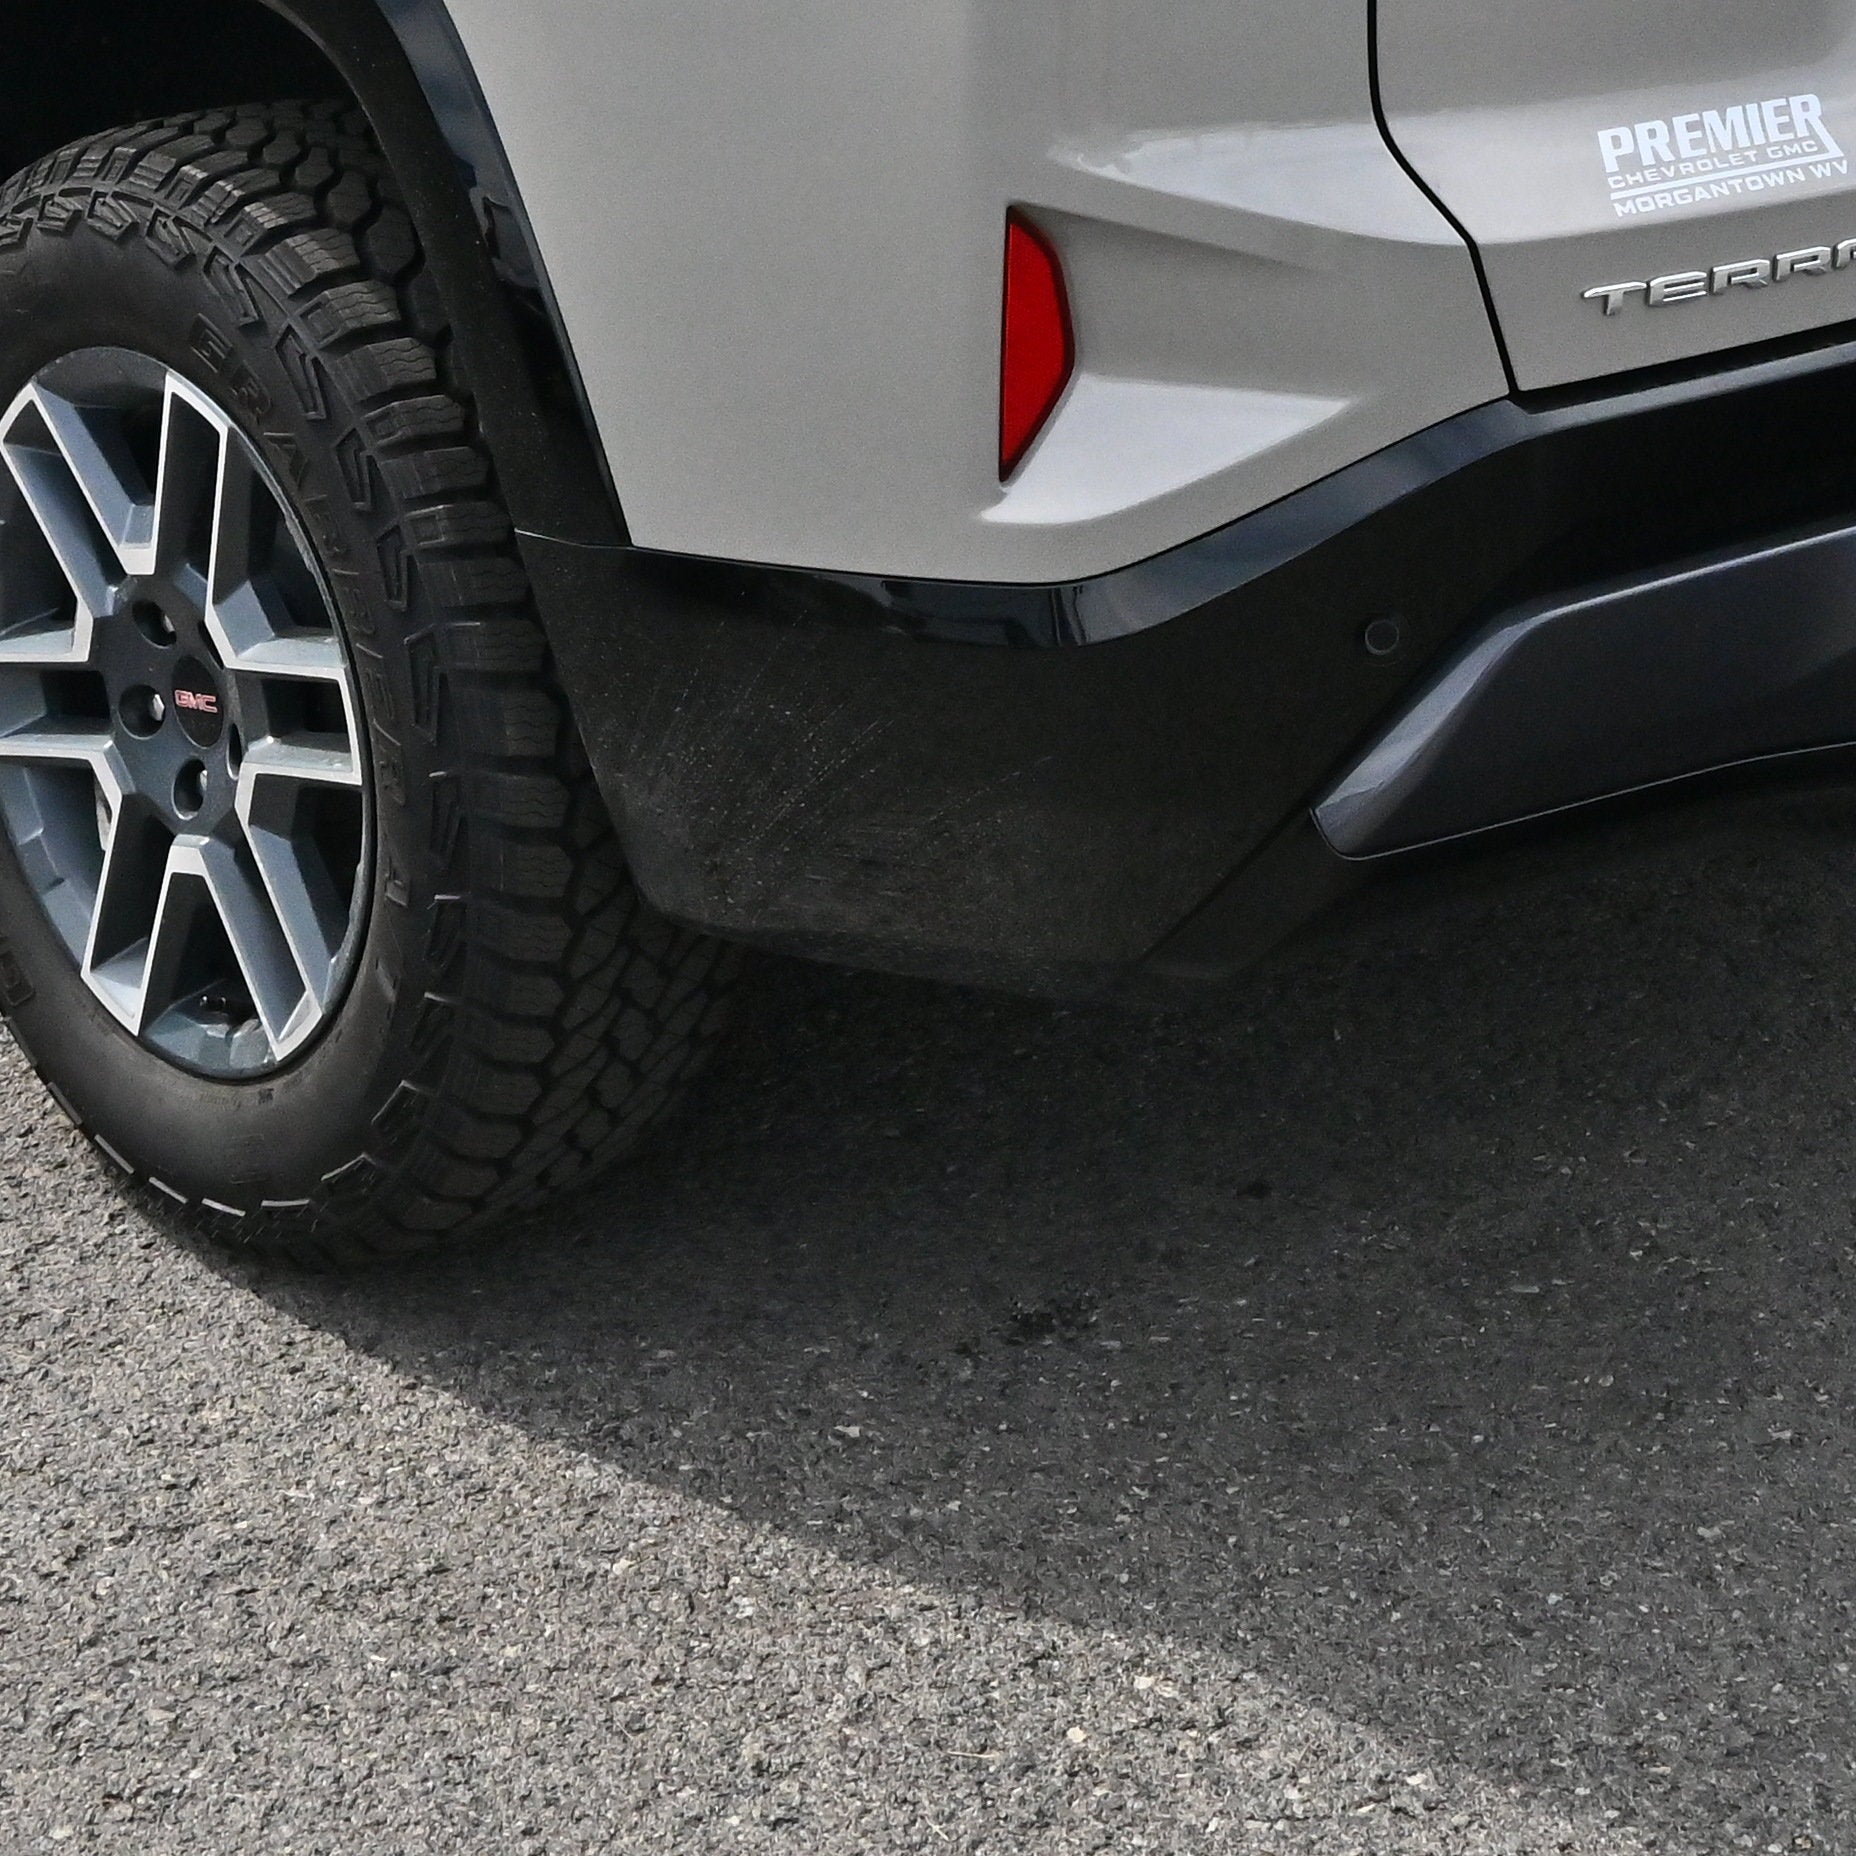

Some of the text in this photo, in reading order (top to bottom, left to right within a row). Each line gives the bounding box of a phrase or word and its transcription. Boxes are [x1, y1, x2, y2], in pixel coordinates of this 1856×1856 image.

[1597, 93, 1825, 173] PREMIER
[1607, 140, 1818, 189] CHEVROLET GMC
[1612, 159, 1848, 217] MORGANTOWN WV
[174, 689, 218, 714] GMC
